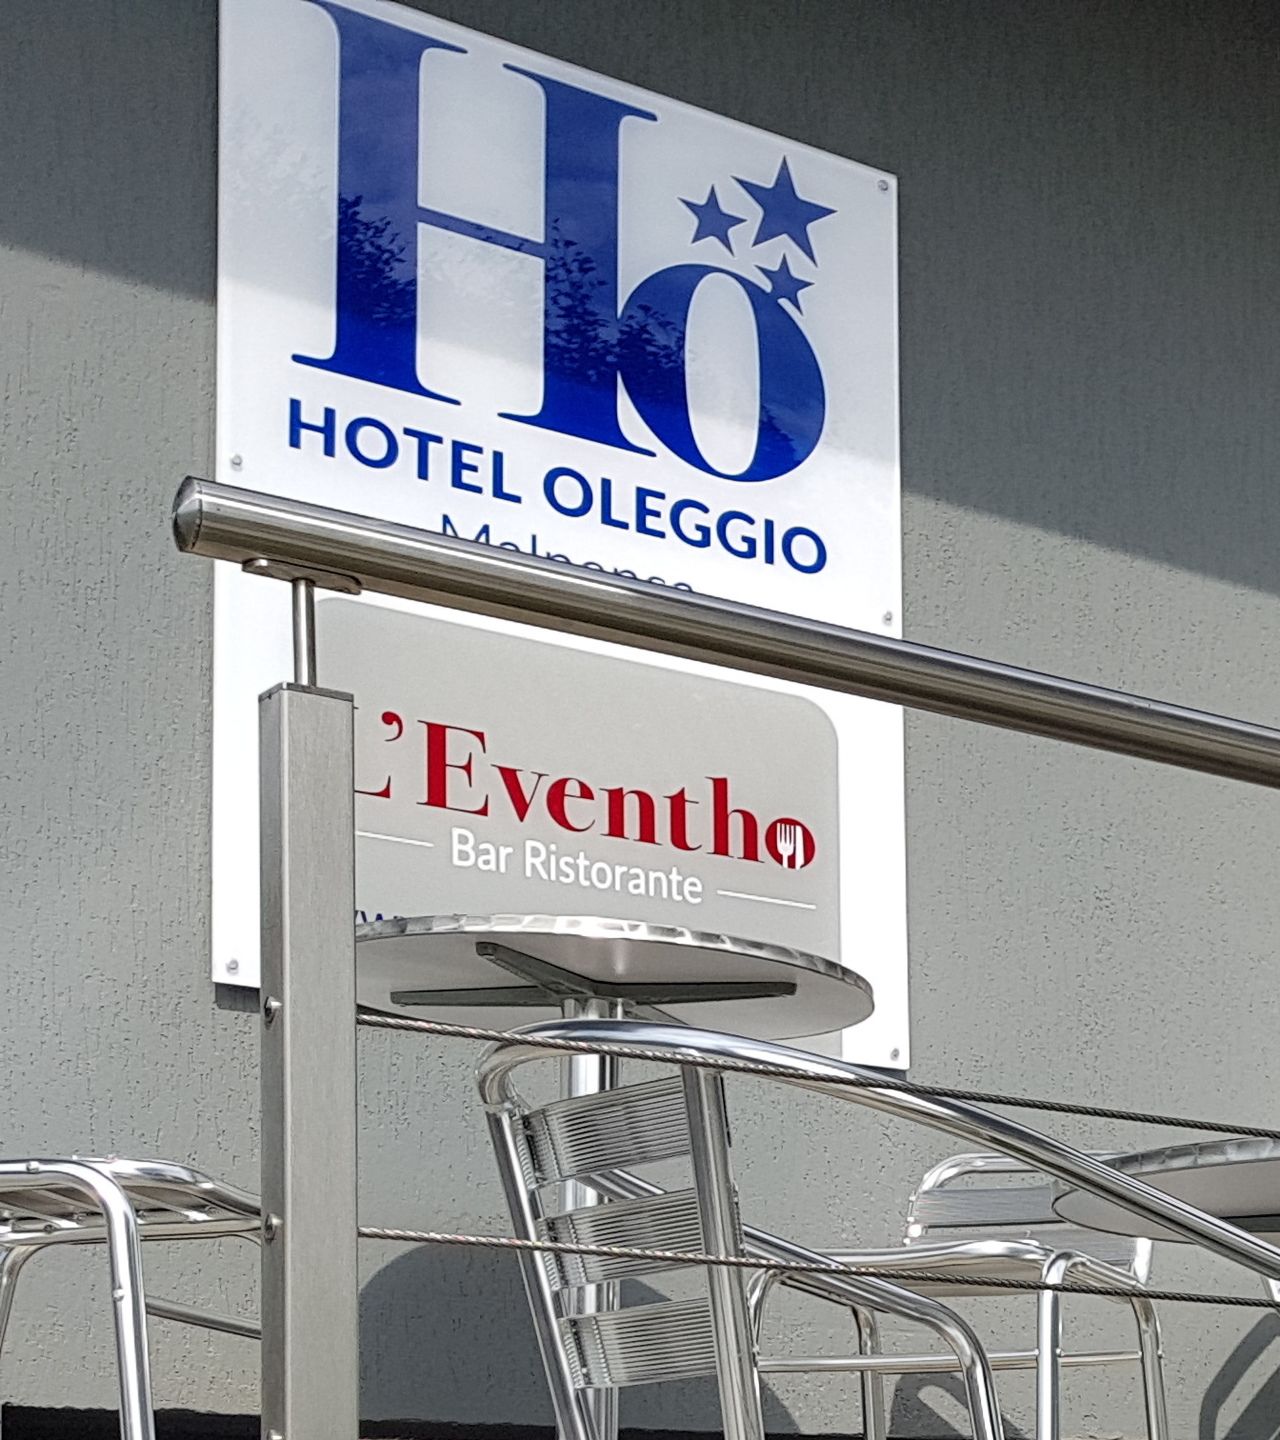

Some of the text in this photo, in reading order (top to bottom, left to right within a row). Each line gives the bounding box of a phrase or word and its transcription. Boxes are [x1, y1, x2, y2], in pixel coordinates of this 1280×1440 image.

[287, 398, 523, 504] HOTEL
[542, 466, 828, 575] OLEGGIO
[450, 827, 703, 904] Bar Ristorante
